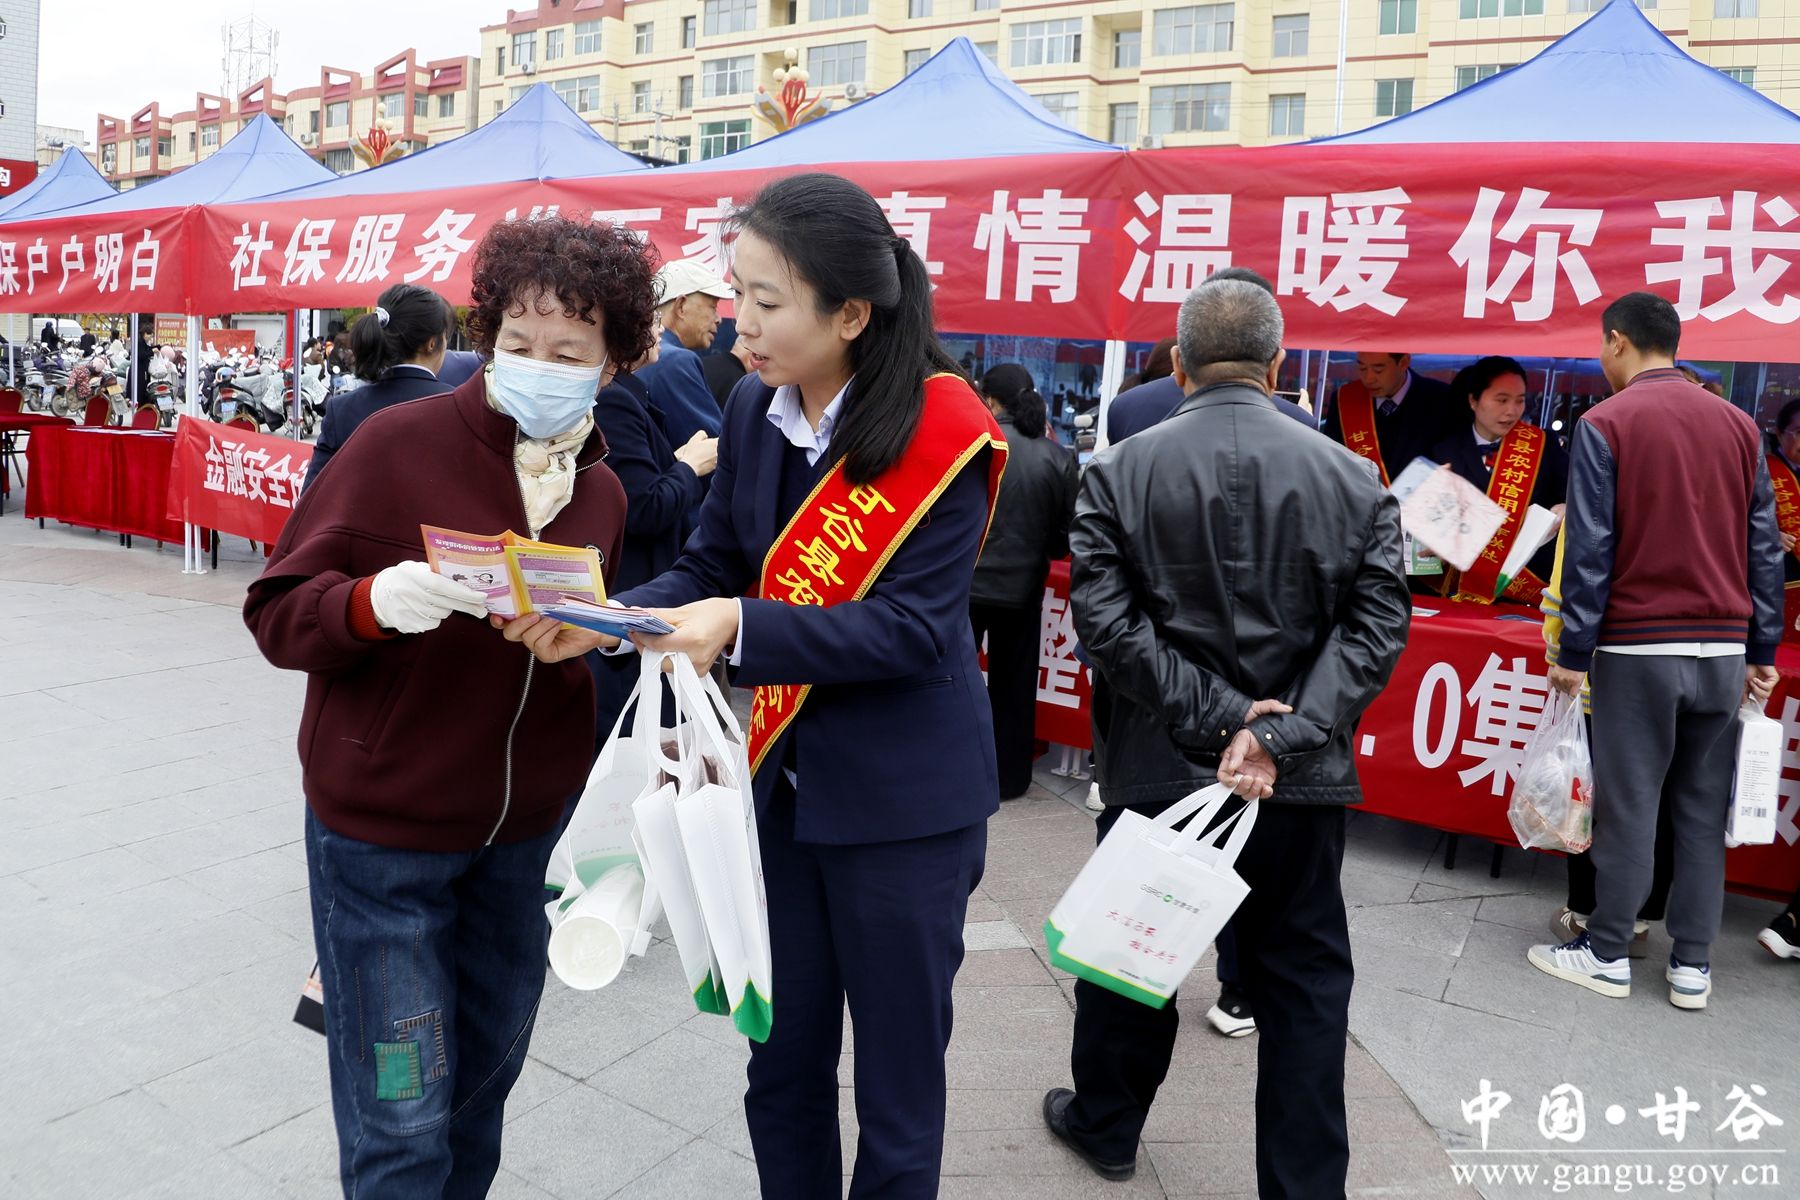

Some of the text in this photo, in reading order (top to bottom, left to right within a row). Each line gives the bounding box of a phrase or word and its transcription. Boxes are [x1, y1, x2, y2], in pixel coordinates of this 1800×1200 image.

[769, 483, 896, 607] 甘谷县农
[1036, 586, 1093, 710] 整
